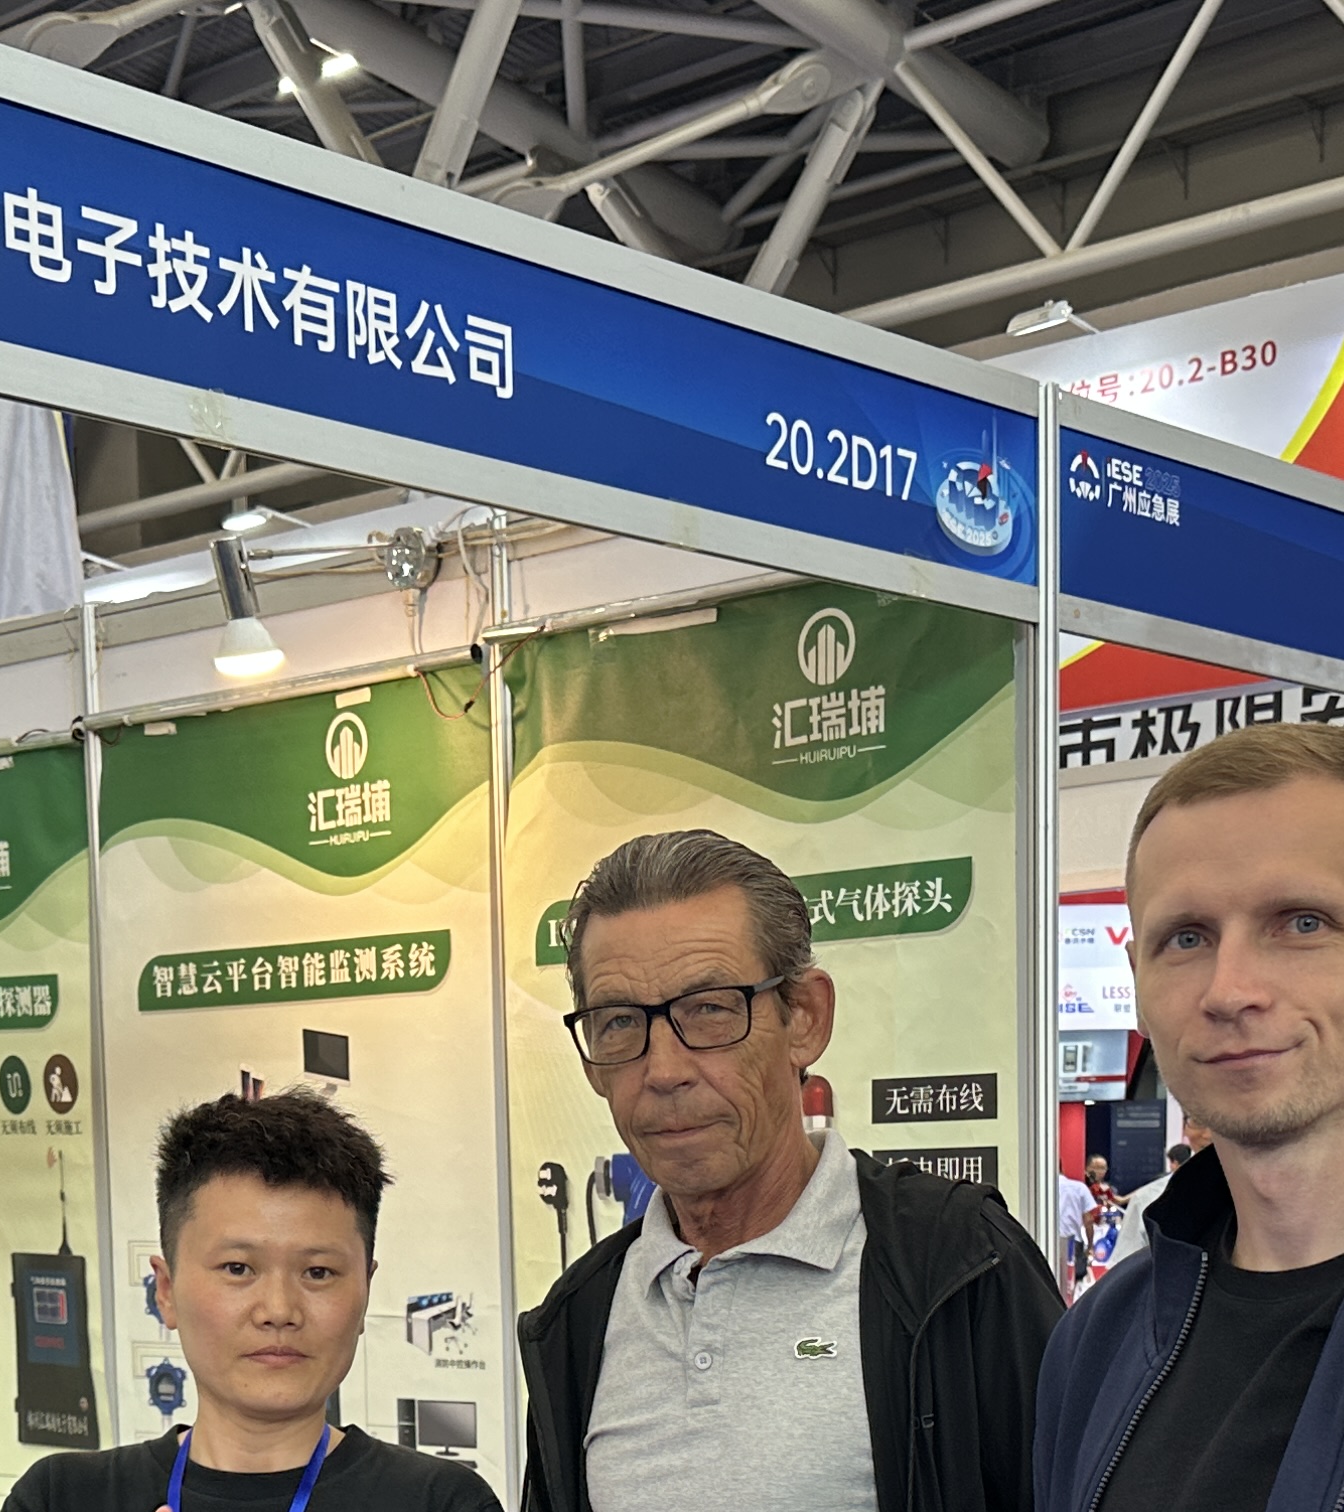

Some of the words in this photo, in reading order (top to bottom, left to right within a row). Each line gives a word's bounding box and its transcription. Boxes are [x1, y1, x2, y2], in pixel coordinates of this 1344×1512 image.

[764, 411, 918, 501] 20.2D17
[1107, 481, 1180, 527] 广州应急展
[771, 685, 885, 749] 汇瑞埔
[799, 745, 856, 765] HUIRUIPU
[307, 779, 391, 833] 汇瑞埔
[153, 941, 436, 999] 智慧云平台智能监测系统
[885, 1082, 984, 1115] 无需布线
